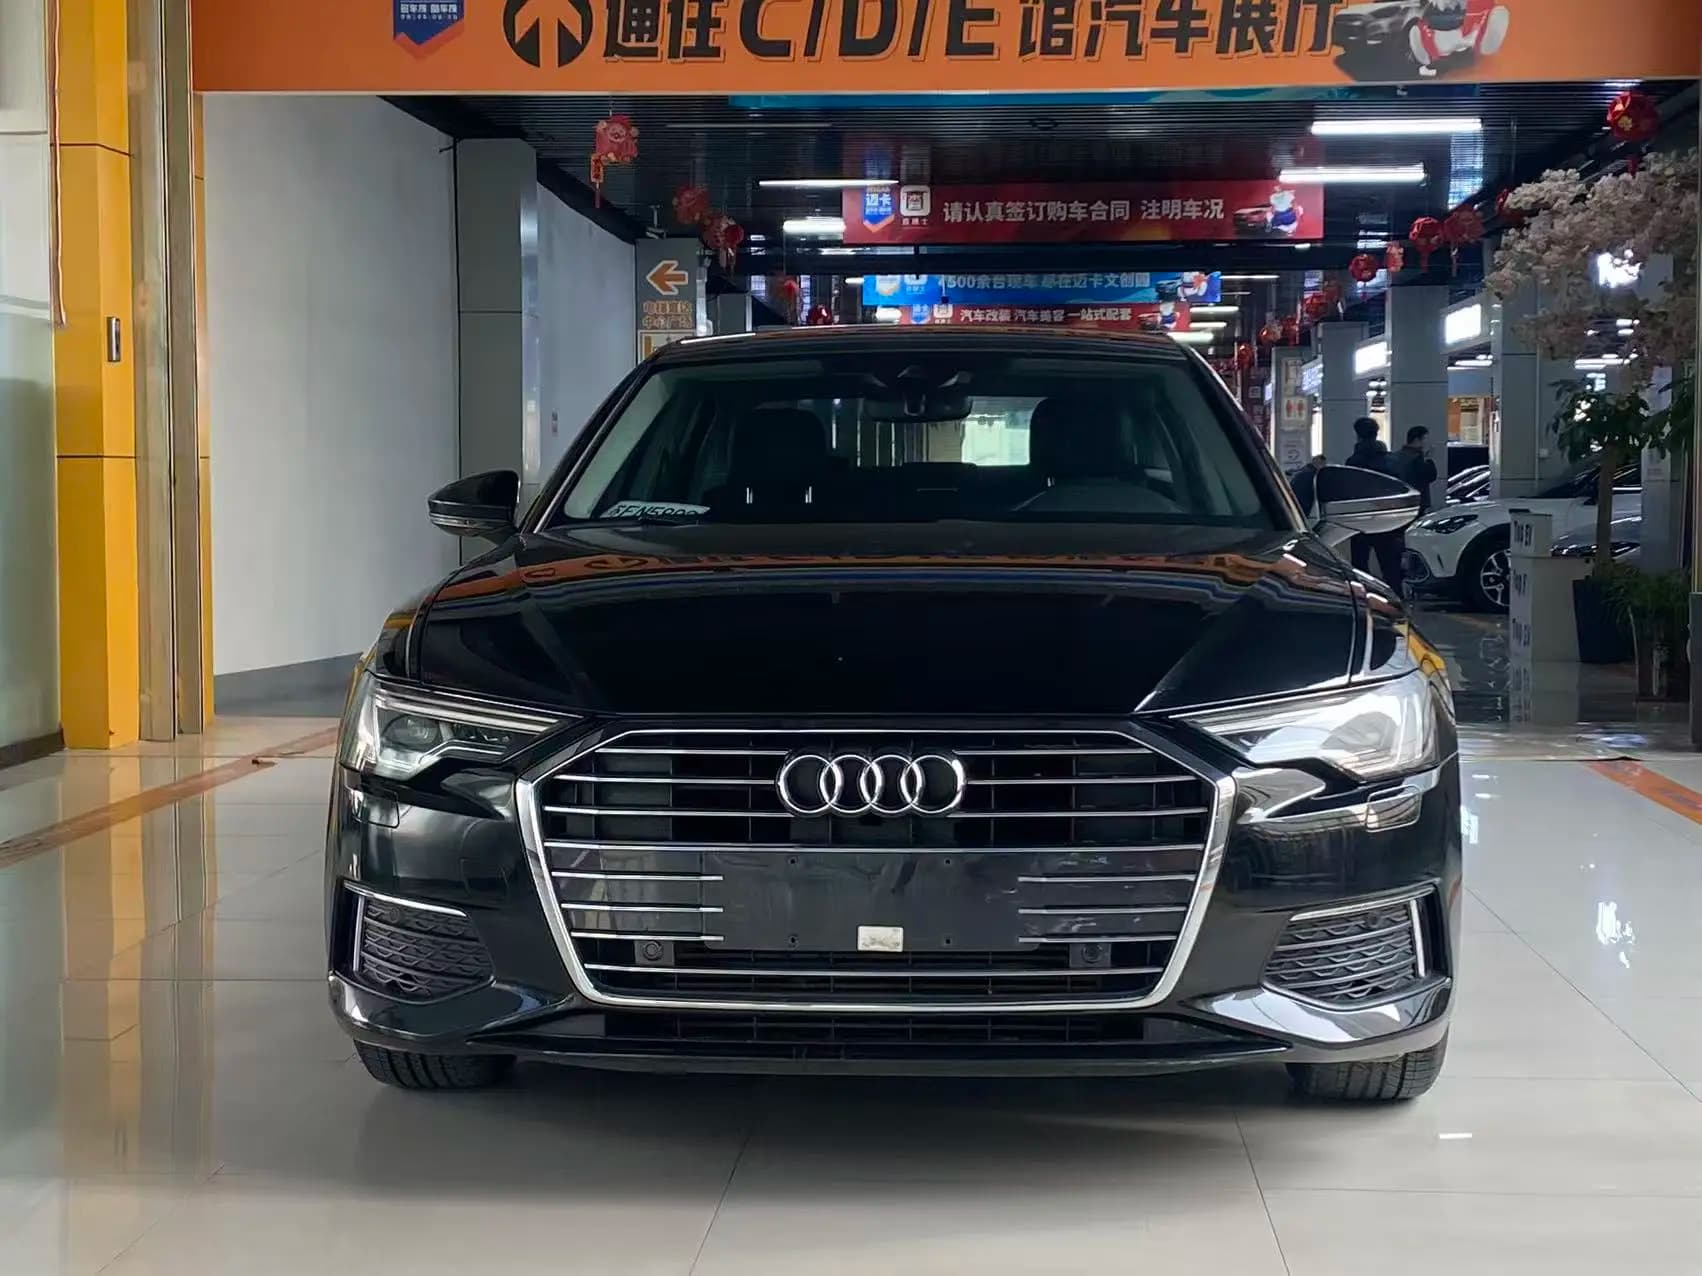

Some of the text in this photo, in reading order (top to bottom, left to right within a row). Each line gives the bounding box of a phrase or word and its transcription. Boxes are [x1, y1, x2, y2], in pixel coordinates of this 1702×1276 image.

[943, 198, 1225, 222] 请认真签订购车合同 注明车况
